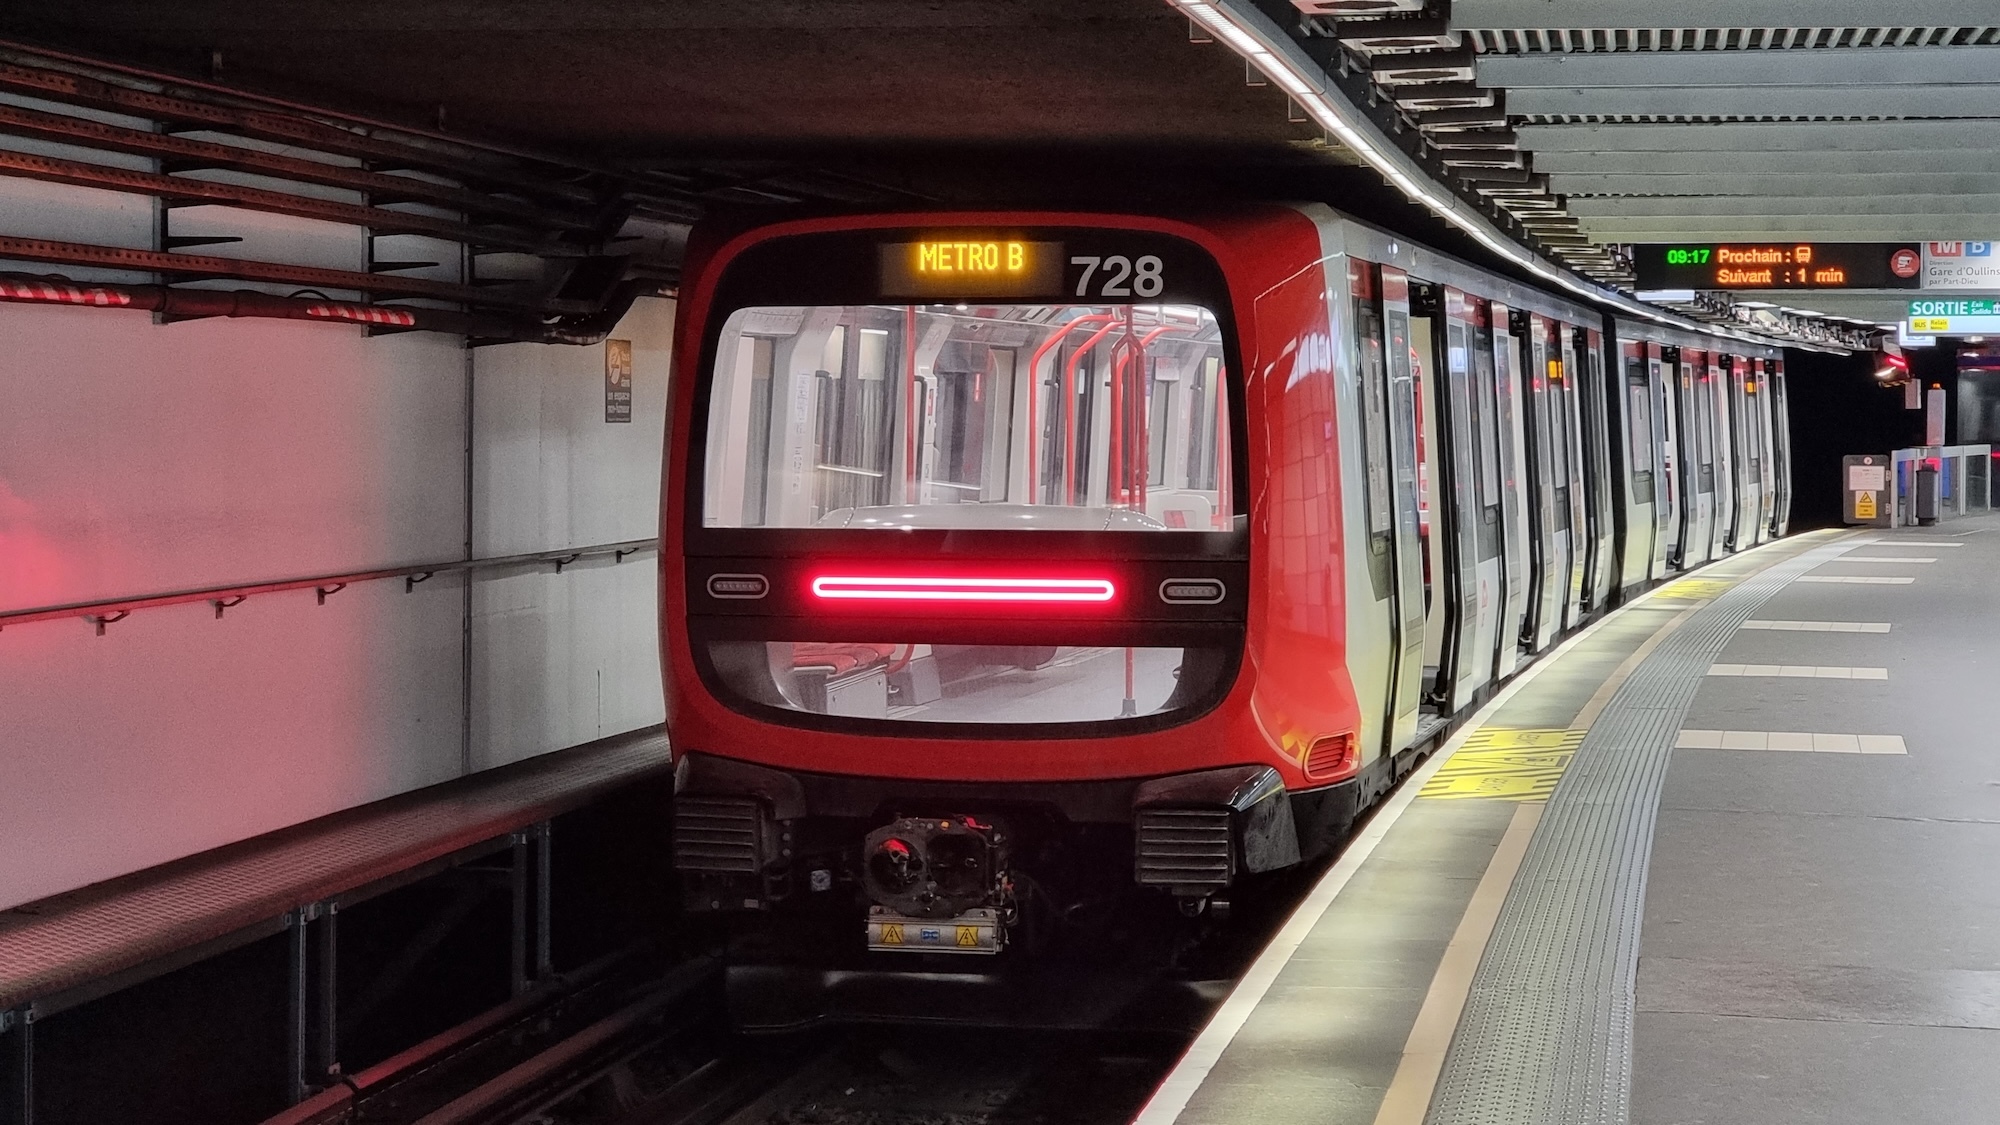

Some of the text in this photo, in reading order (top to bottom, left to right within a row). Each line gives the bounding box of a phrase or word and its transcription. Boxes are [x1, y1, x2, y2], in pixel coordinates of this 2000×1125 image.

[919, 243, 1024, 271] METRO B
[1667, 249, 1710, 264] 09:17
[1718, 248, 1782, 264] Prochain
[1071, 255, 1164, 297] 728
[1717, 268, 1772, 283] Suivant
[1797, 268, 1806, 283] 1
[1815, 268, 1844, 283] min
[1929, 267, 1953, 276] Gare
[1912, 301, 1969, 315] SORTIE
